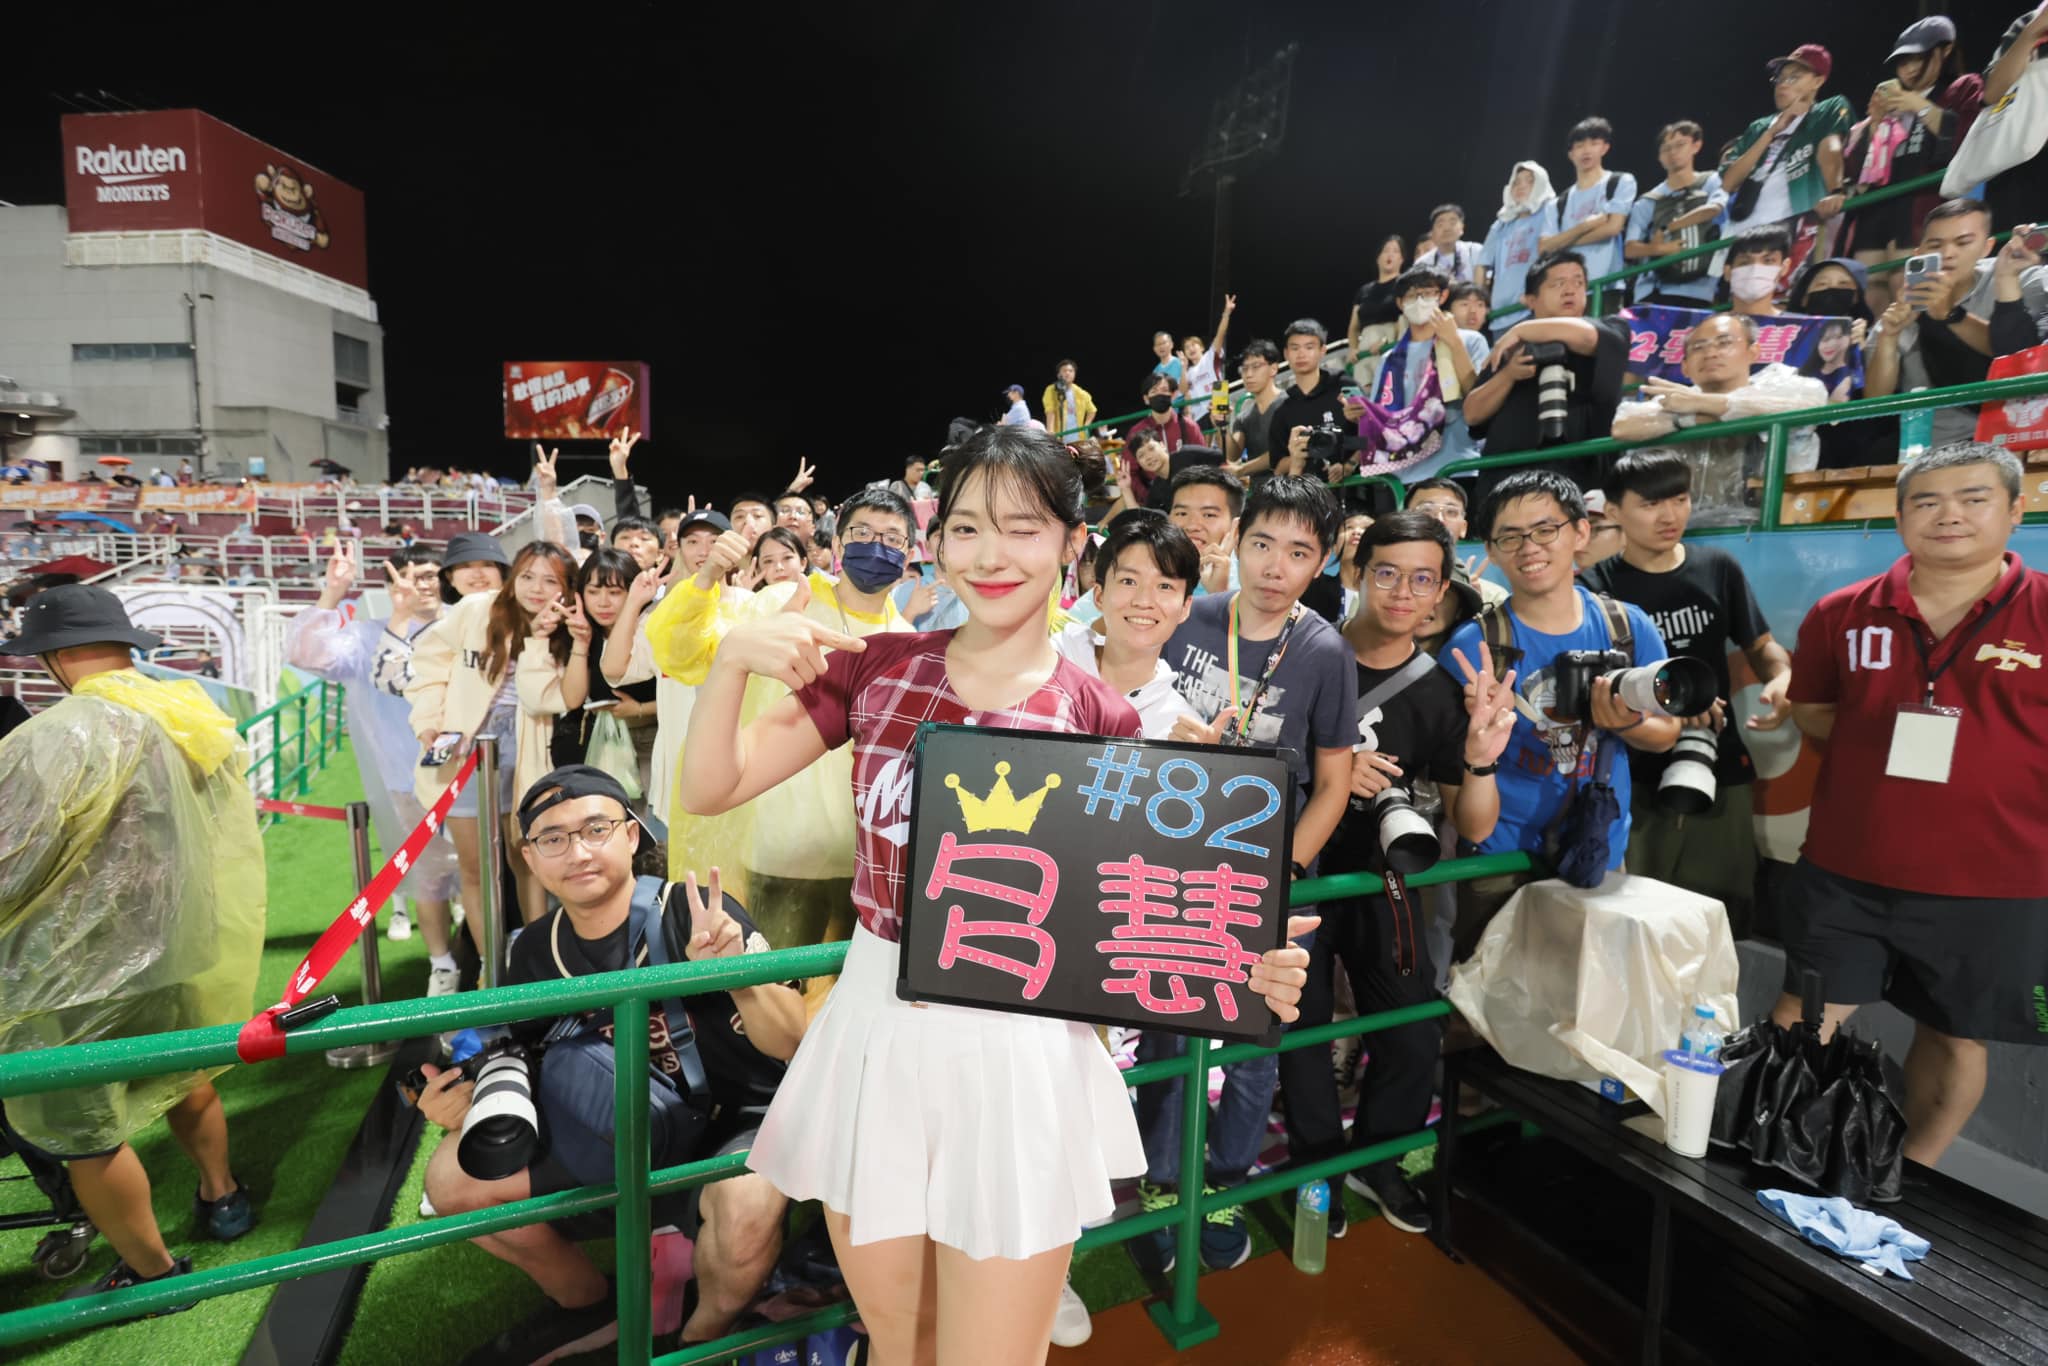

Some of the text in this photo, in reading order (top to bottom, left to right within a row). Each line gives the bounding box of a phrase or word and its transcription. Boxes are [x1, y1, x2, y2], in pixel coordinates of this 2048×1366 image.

[76, 144, 186, 175] Rakuten
[96, 184, 170, 203] MONKEYS
[1182, 644, 1219, 674] THE
[1846, 625, 1893, 672] 10
[1077, 744, 1282, 859] #82
